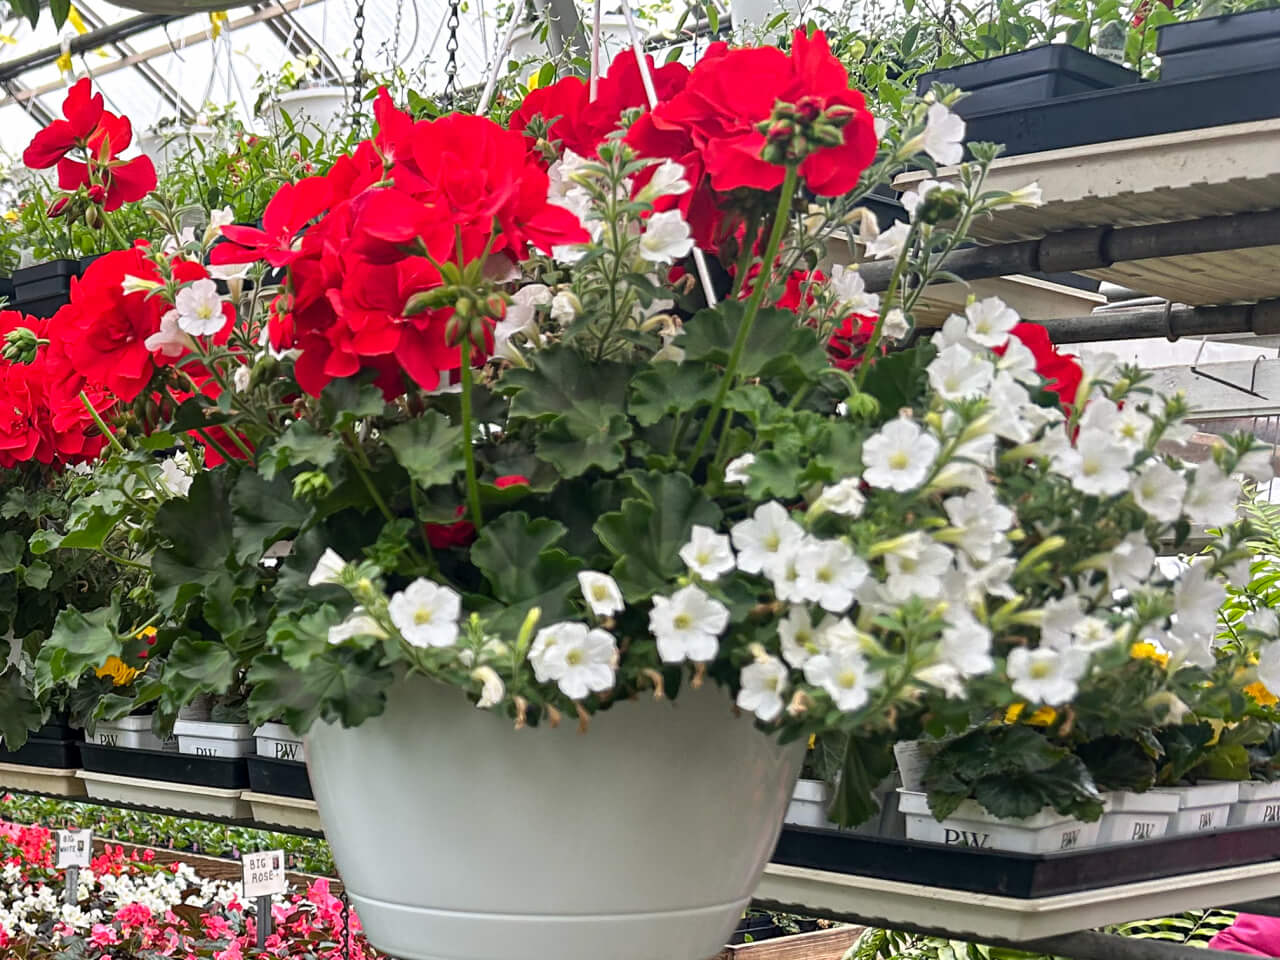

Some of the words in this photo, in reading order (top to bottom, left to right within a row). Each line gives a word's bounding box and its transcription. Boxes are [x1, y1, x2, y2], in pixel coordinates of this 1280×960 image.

[274, 742, 299, 761] PW
[944, 828, 990, 849] PW
[249, 858, 266, 870] BIG
[252, 870, 274, 884] ROSE
